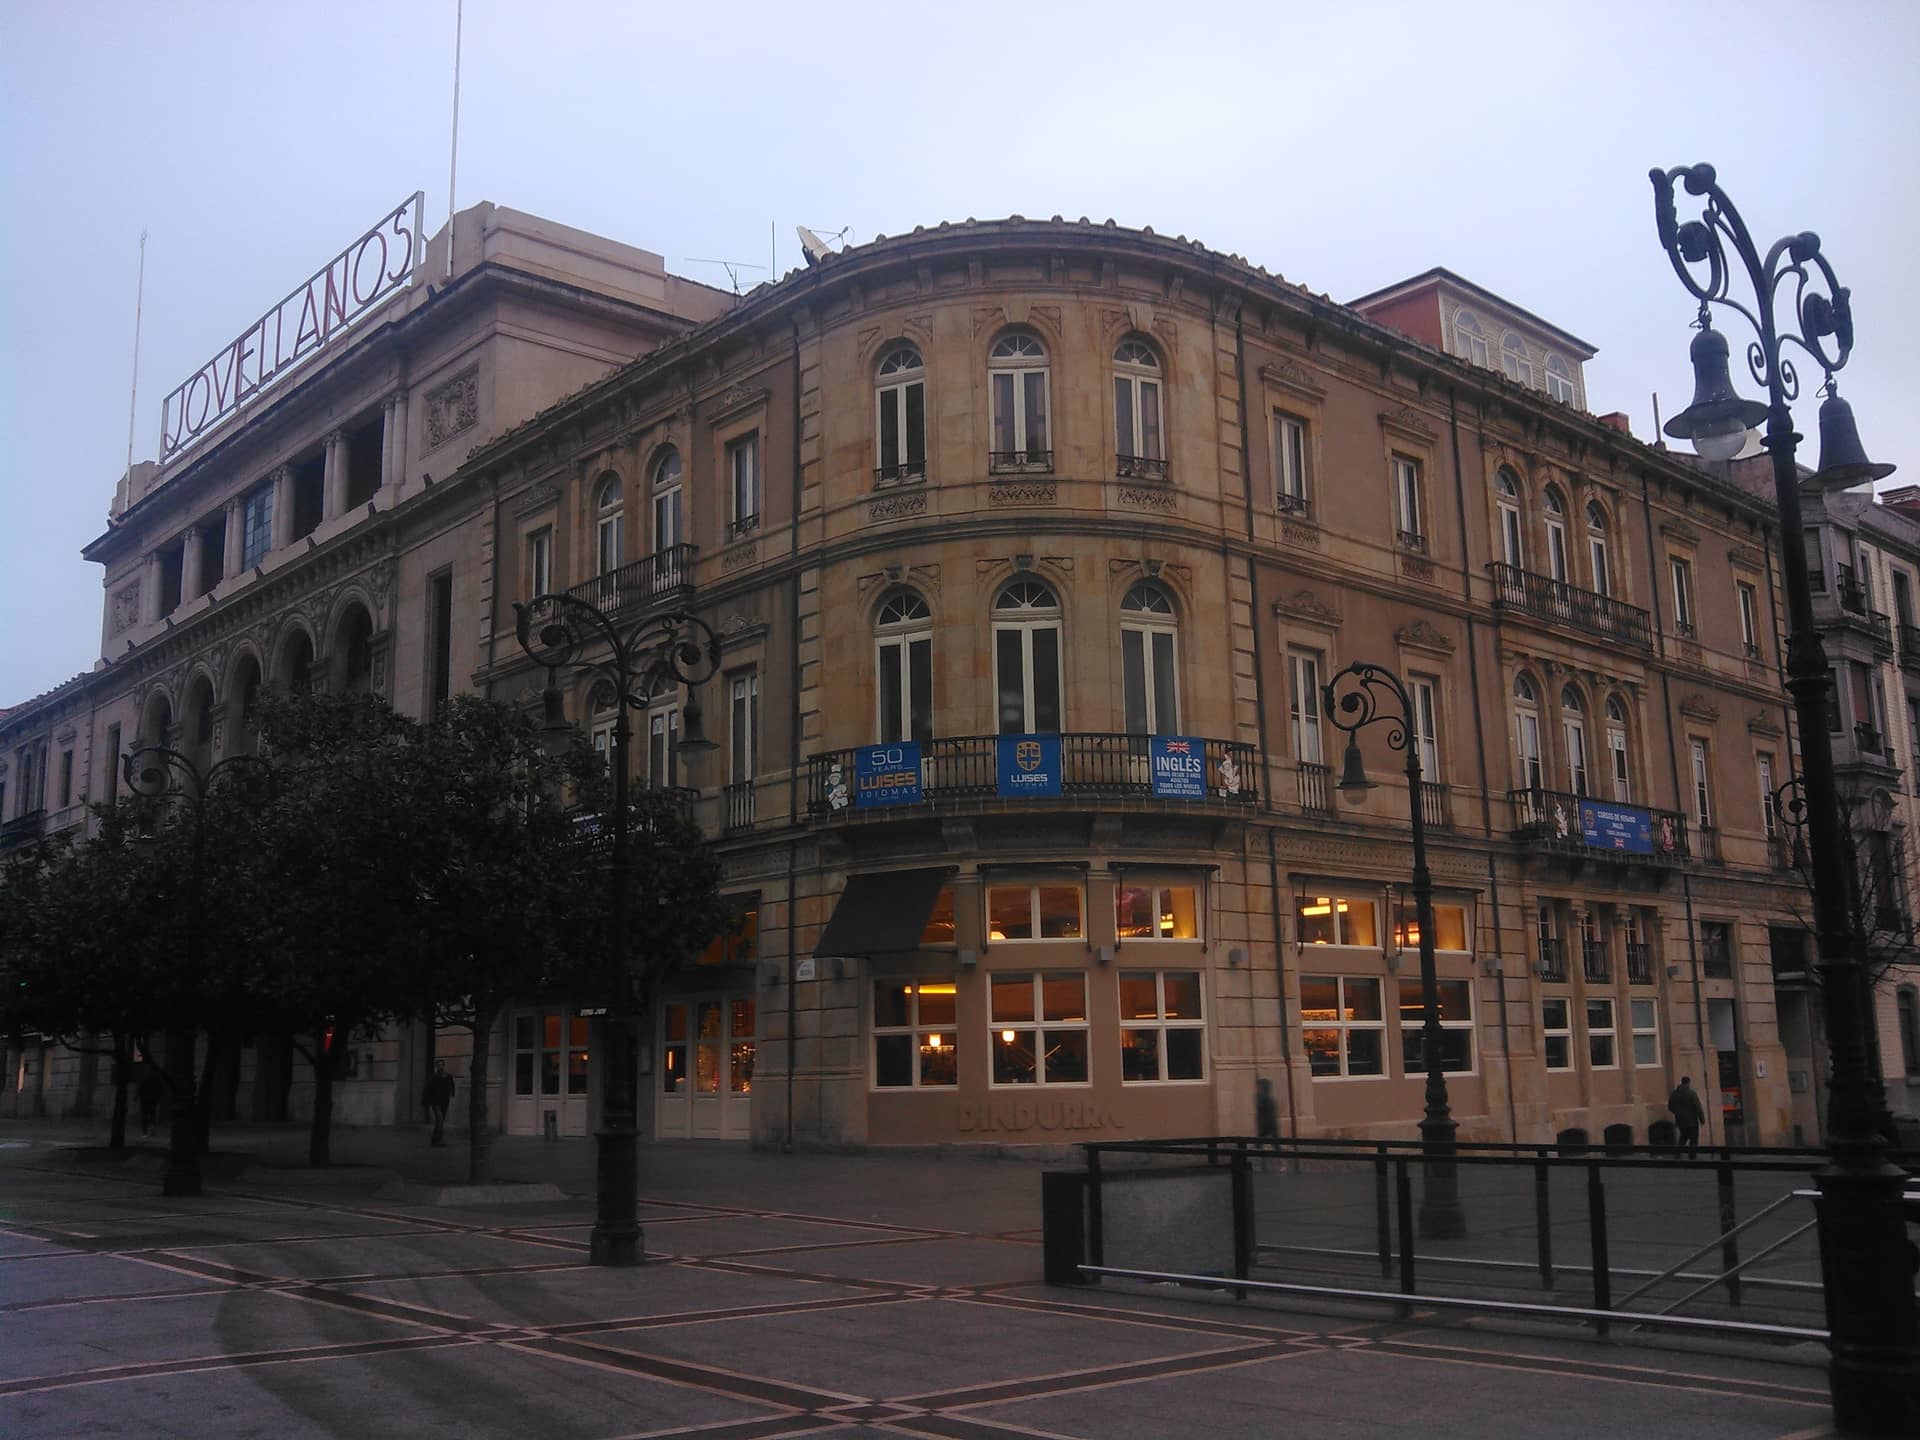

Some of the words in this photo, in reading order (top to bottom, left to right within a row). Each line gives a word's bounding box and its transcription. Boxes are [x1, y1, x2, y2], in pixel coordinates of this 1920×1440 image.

[164, 206, 412, 454] JOVELLANOS
[871, 748, 903, 766] 50
[1156, 755, 1201, 772] INGLÉS
[860, 771, 917, 791] LUISES
[1010, 773, 1048, 783] LUISES
[860, 786, 918, 799] IDIOMAS
